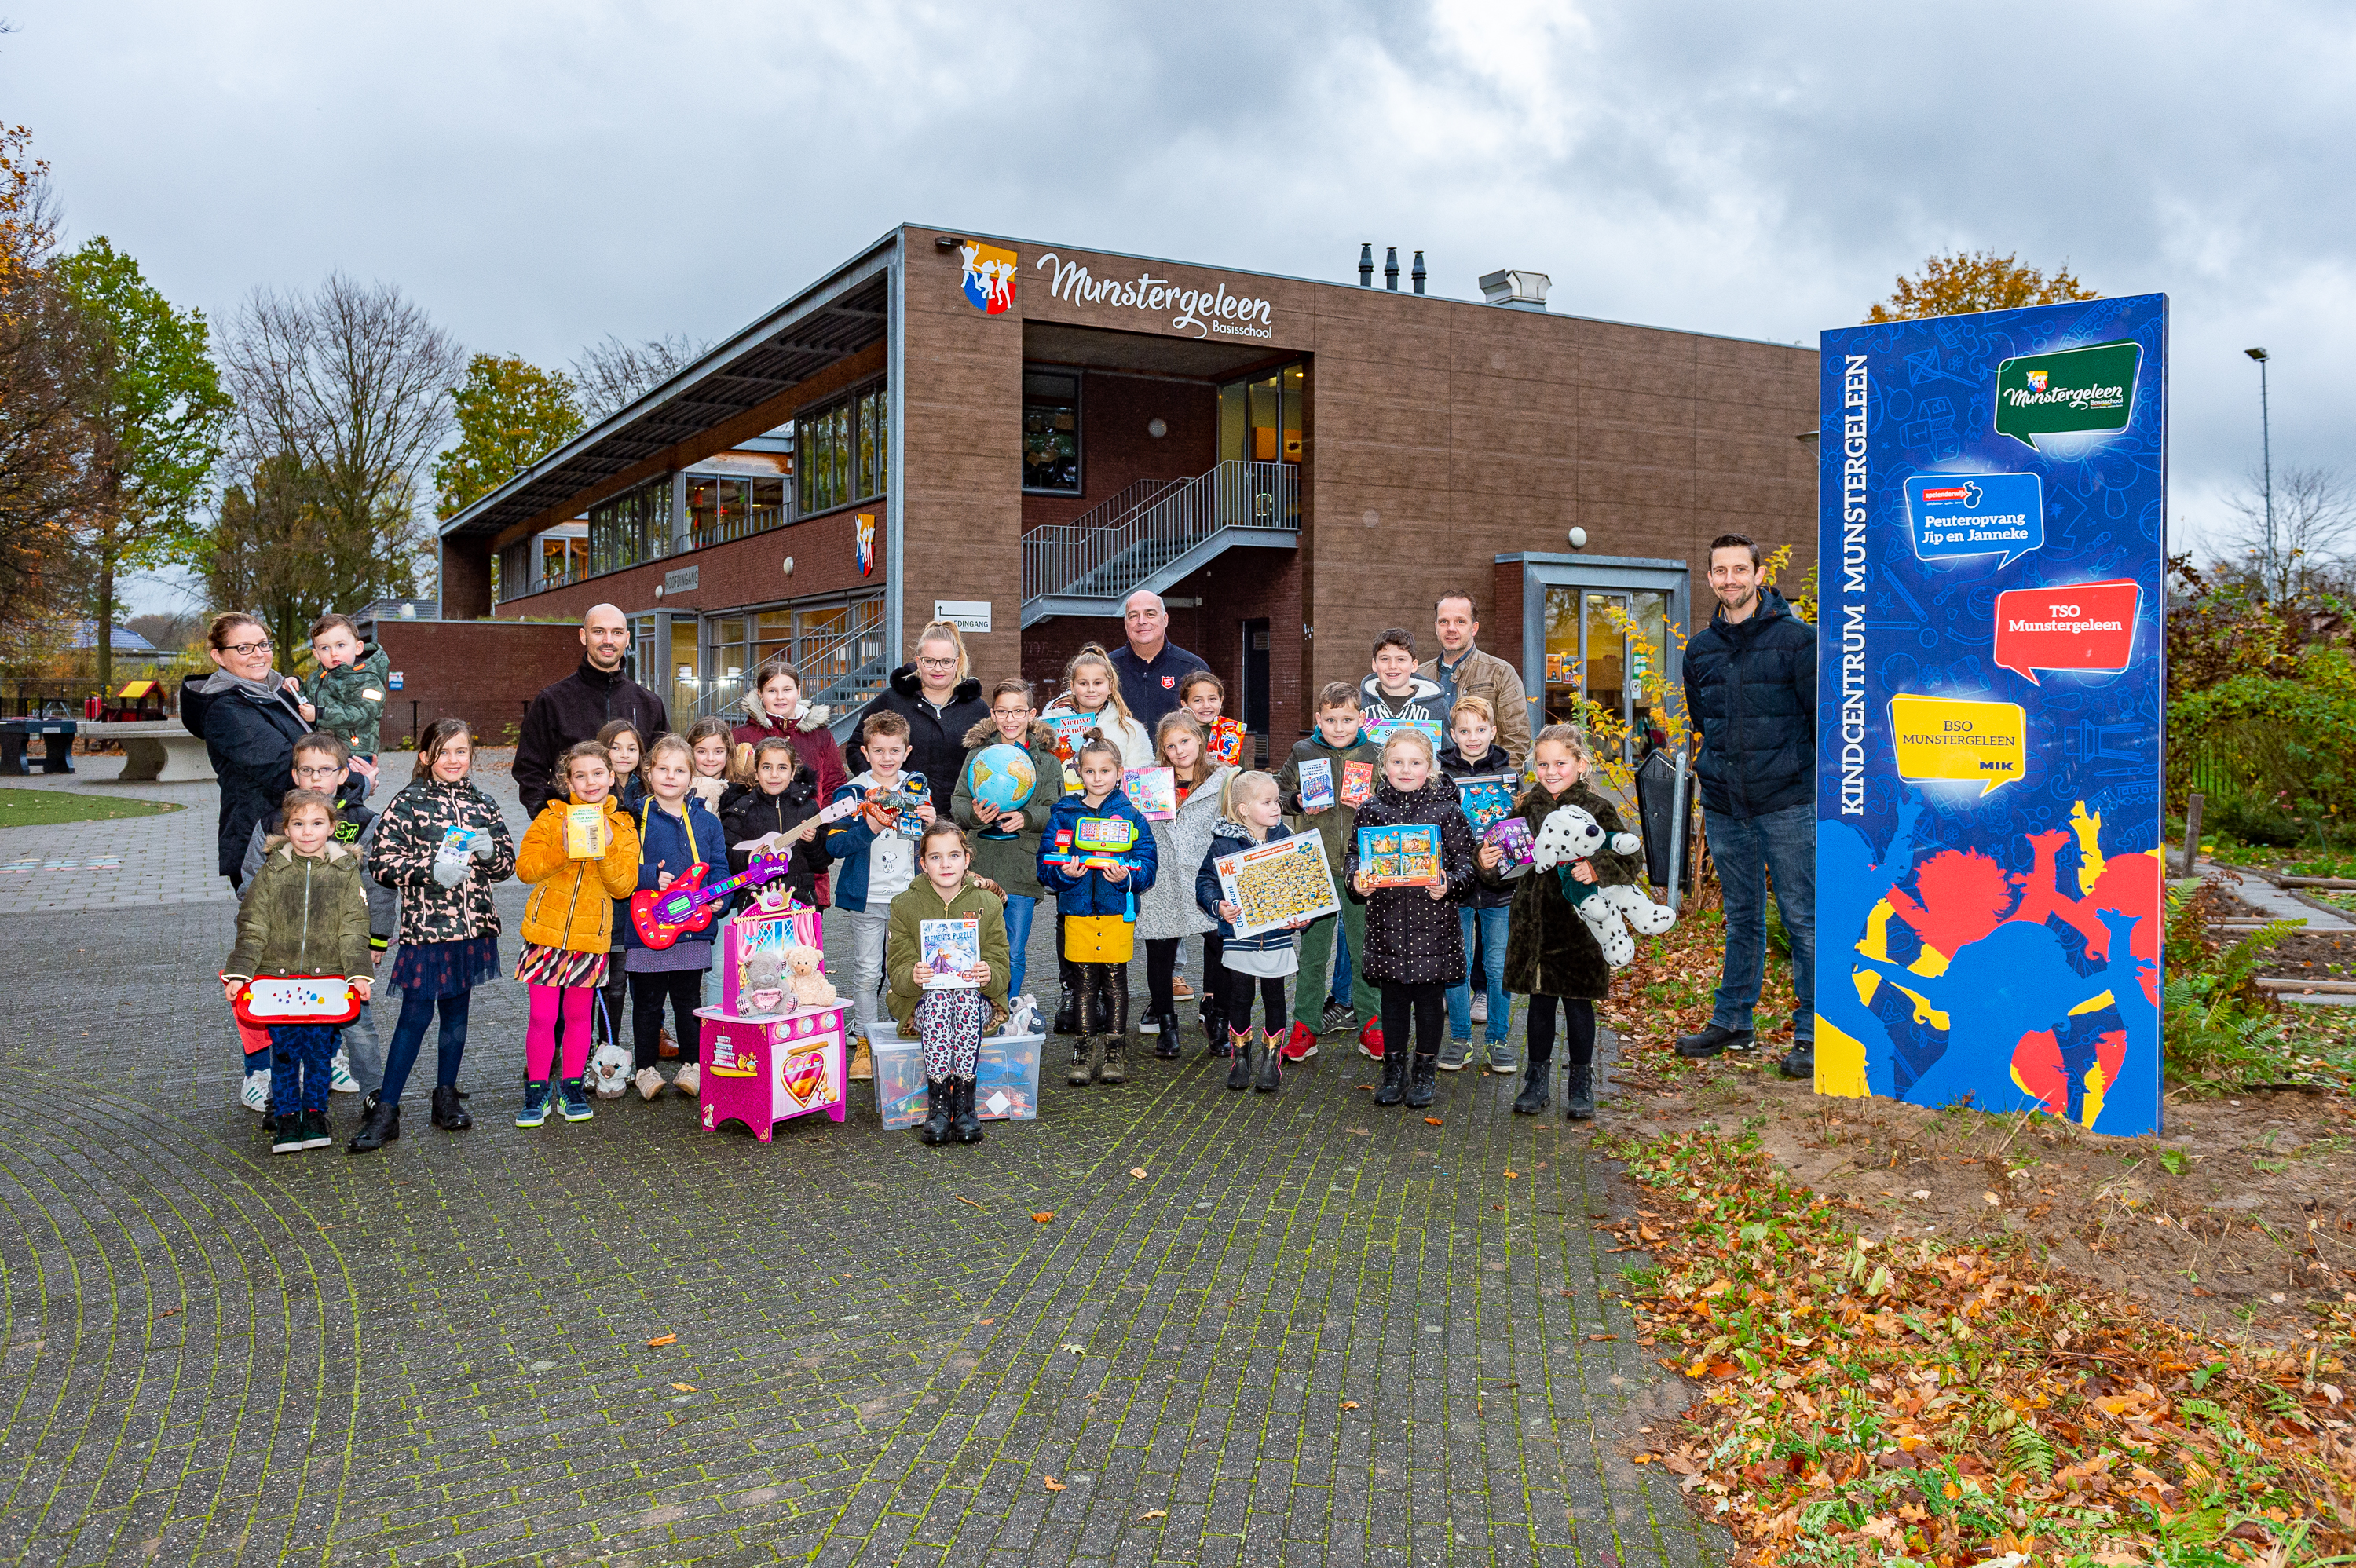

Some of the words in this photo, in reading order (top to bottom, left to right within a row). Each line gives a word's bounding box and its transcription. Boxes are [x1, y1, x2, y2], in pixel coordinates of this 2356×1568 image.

[1036, 253, 1271, 338] Munstergeleen
[1213, 320, 1272, 338] Basisschool
[2003, 383, 2123, 410] Munstergeleen
[1843, 354, 1868, 593] MUNSTERGELEEN
[1926, 490, 1966, 499] spelenderwijs
[1925, 514, 2025, 528] Peuteropvang
[1922, 532, 1944, 545] Jip
[1946, 532, 1964, 542] en
[1967, 527, 2028, 542] Janneke
[2049, 605, 2080, 618] TSO
[2008, 619, 2122, 634] Munstergeleen
[1841, 604, 1866, 816] KINDCENTRUM
[1060, 717, 1091, 726] Nieuwe
[1944, 720, 1973, 732] BSO
[1903, 734, 2015, 746] MUNSTERGELEEN
[1980, 762, 2014, 771] MIK
[335, 821, 359, 843] 97
[1251, 849, 1275, 858] IMPOSSIBLE
[1220, 862, 1237, 877] ME
[924, 934, 950, 942] ELEMENTS
